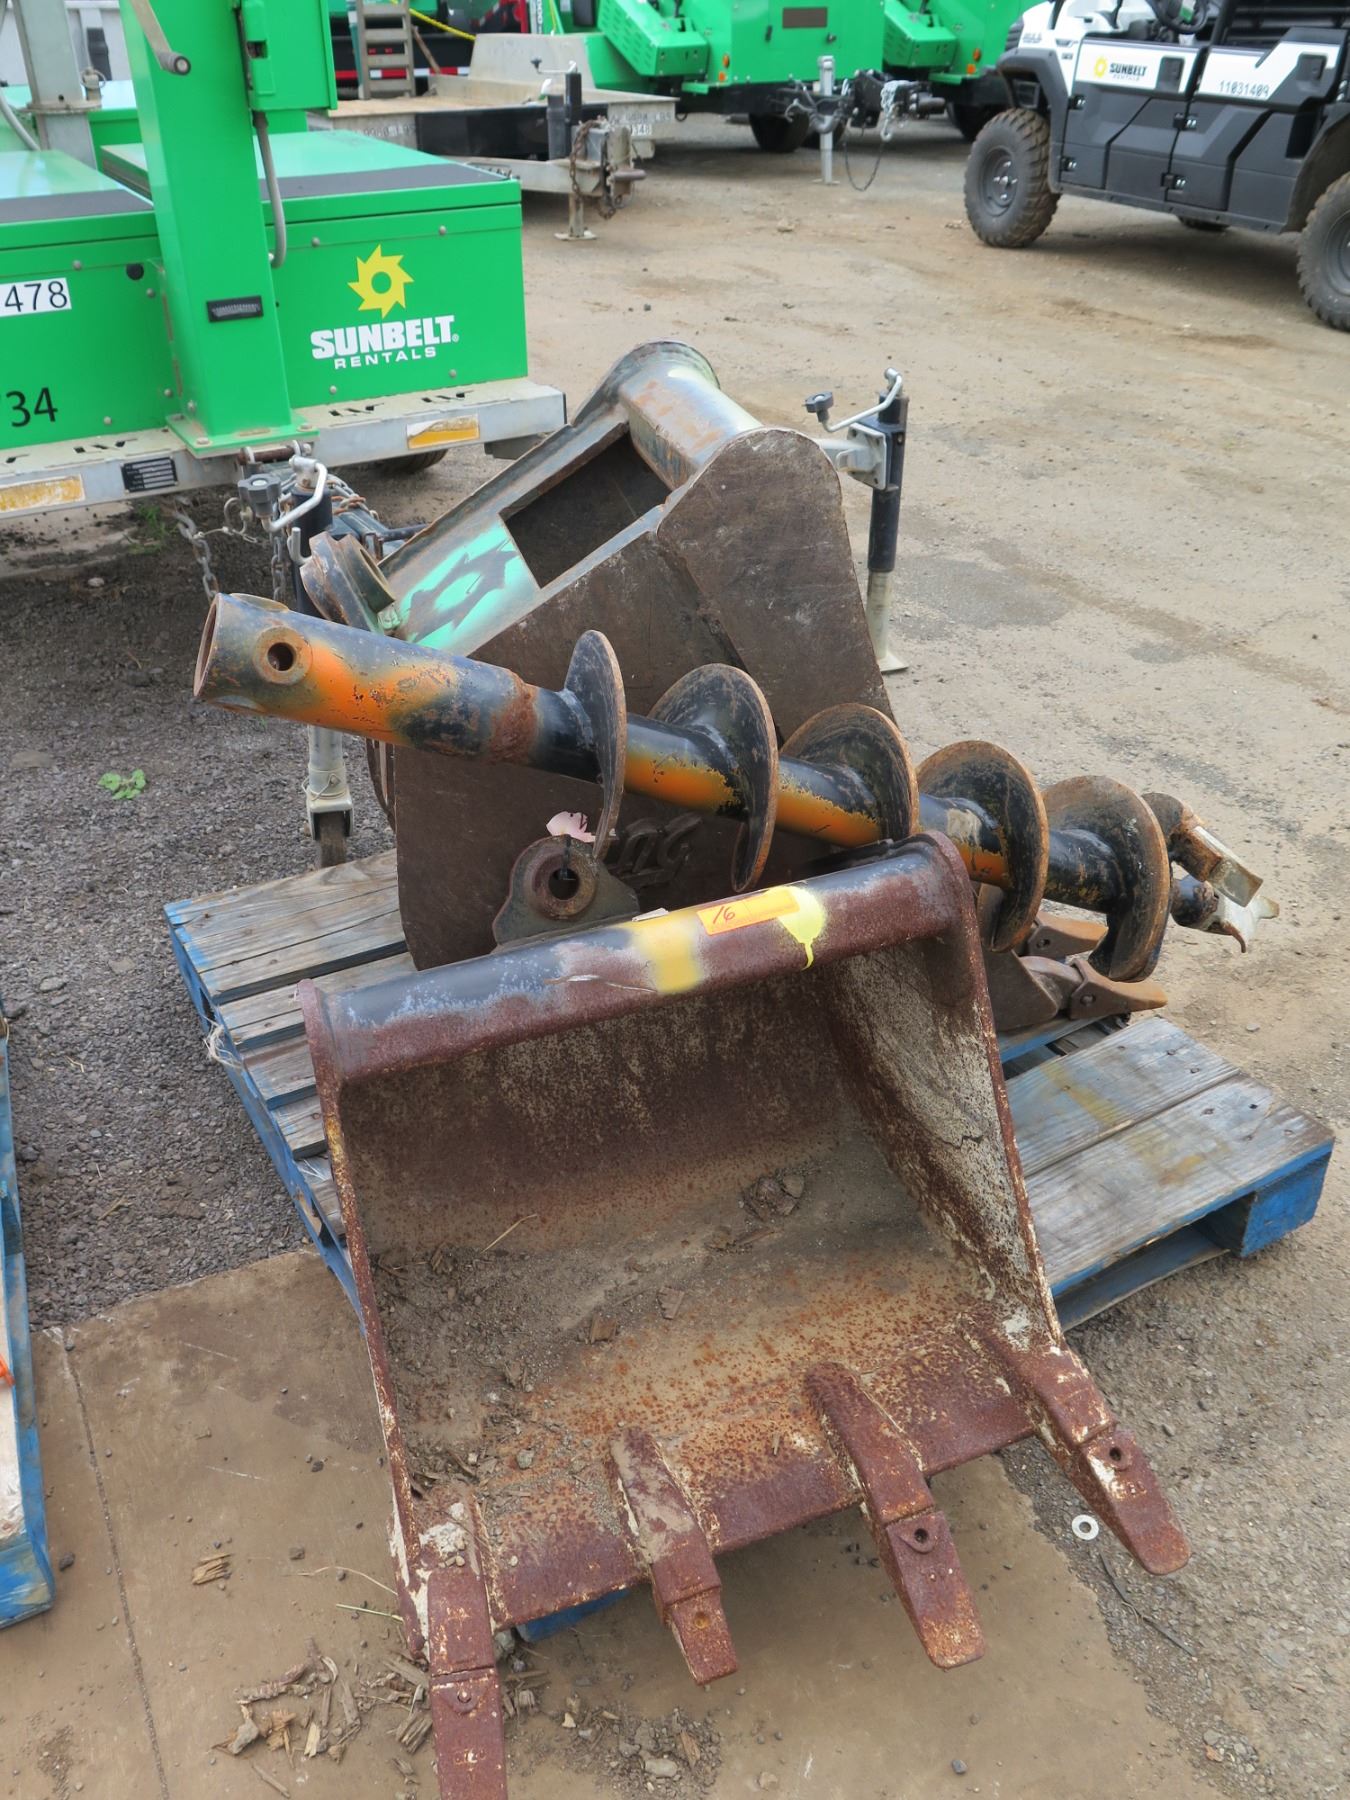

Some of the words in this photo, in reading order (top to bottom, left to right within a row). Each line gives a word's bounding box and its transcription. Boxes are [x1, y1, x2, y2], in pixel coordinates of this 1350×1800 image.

[1110, 63, 1148, 77] SUNBELT
[4, 280, 68, 312] 478
[310, 315, 456, 360] SUNBELT
[334, 346, 437, 370] RENTALS
[6, 387, 59, 428] 34
[712, 905, 736, 925] 16
